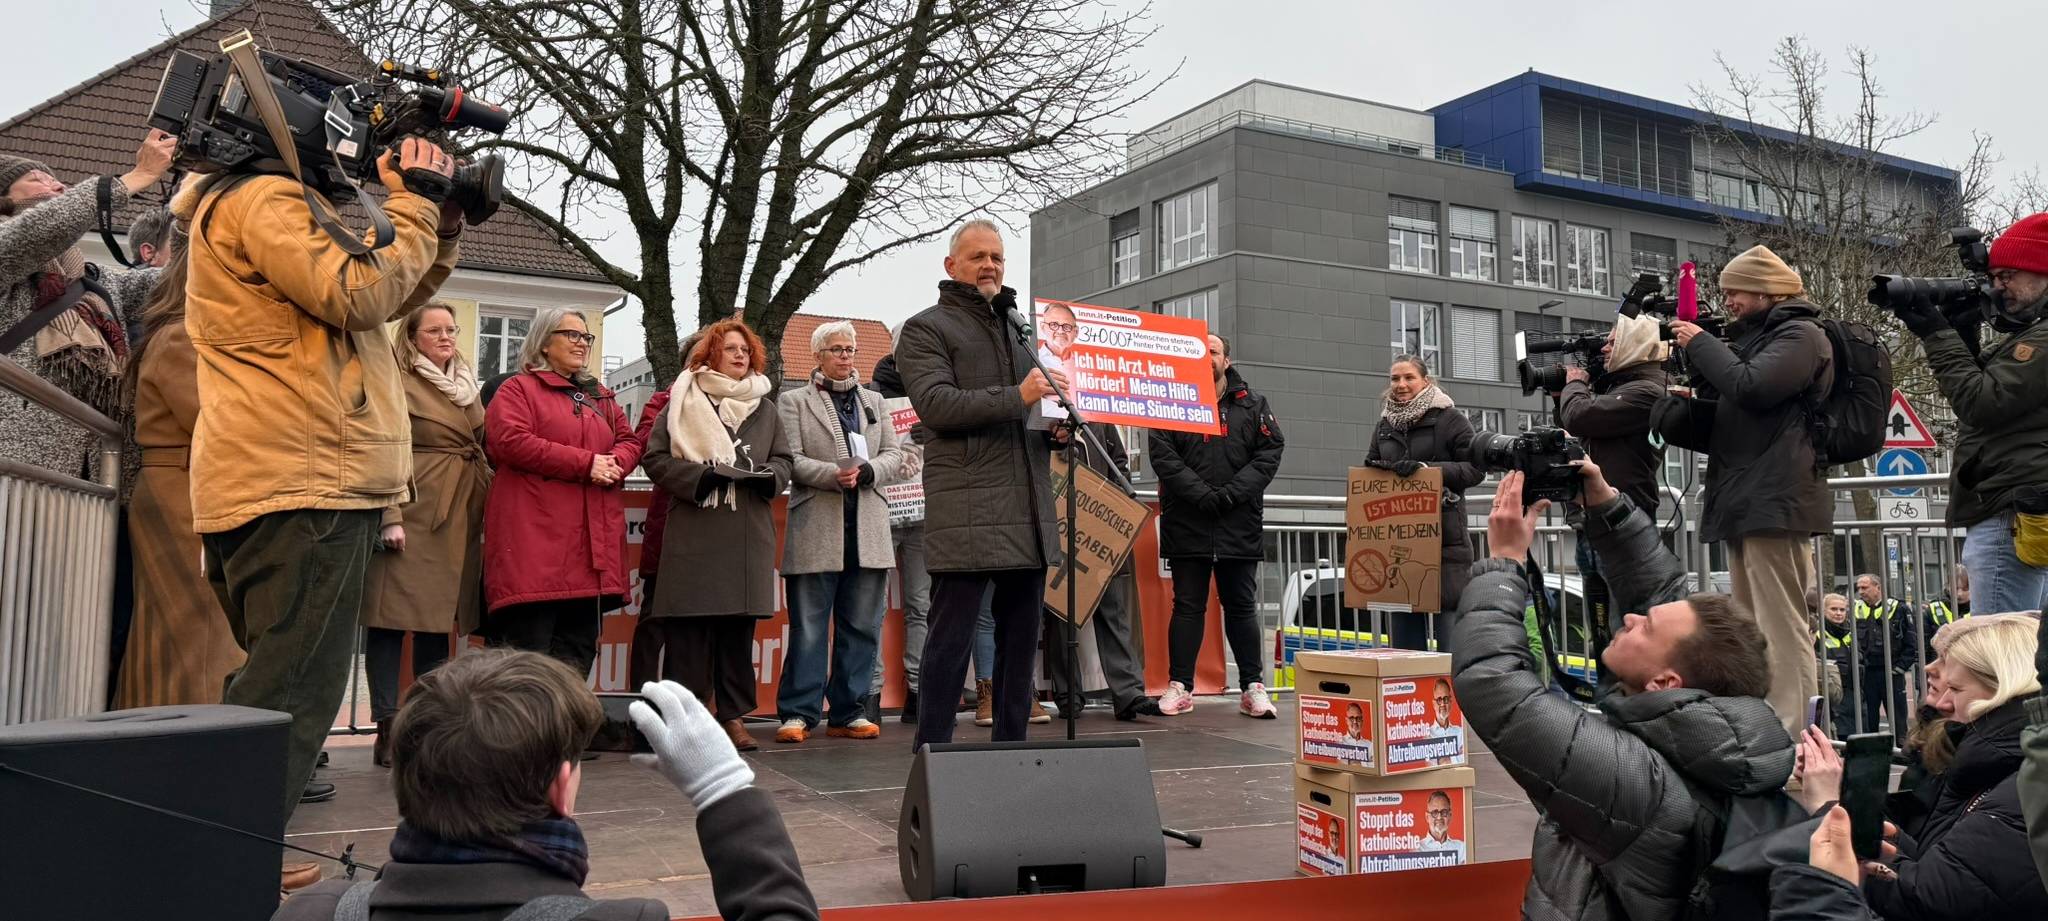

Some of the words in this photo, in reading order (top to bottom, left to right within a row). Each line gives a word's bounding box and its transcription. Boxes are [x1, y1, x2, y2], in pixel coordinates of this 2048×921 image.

[1078, 310, 1137, 324] innn.it-Petition
[1133, 332, 1169, 342] Menschen
[1170, 337, 1194, 346] stehen
[1134, 341, 1154, 349] hinter
[1155, 343, 1171, 352] Prof.
[1074, 351, 1094, 369] Ich
[1096, 354, 1116, 371] bin
[1118, 356, 1146, 377] Arzt,
[1148, 360, 1175, 379] kein
[1075, 371, 1126, 393] Mörder!
[1129, 377, 1167, 398] Meine
[1168, 382, 1197, 401] Hilfe
[1077, 391, 1109, 412] kann
[1111, 395, 1146, 416] keine
[1147, 399, 1186, 420] Sünde
[1187, 405, 1214, 423] sein
[1351, 479, 1389, 494] EURE
[1392, 479, 1439, 493] MORAL
[1366, 503, 1387, 518] IST
[1390, 496, 1435, 514] NICHT
[1348, 526, 1386, 541] MEINE
[1325, 712, 1338, 726] das
[1385, 699, 1411, 720] Stoppt
[1411, 698, 1425, 716] das
[1386, 719, 1431, 741] katholische
[1388, 738, 1457, 764] Abtreibungsverbot
[1359, 811, 1394, 832] Stoppt
[1395, 810, 1414, 828] das
[1360, 832, 1421, 852] katholische
